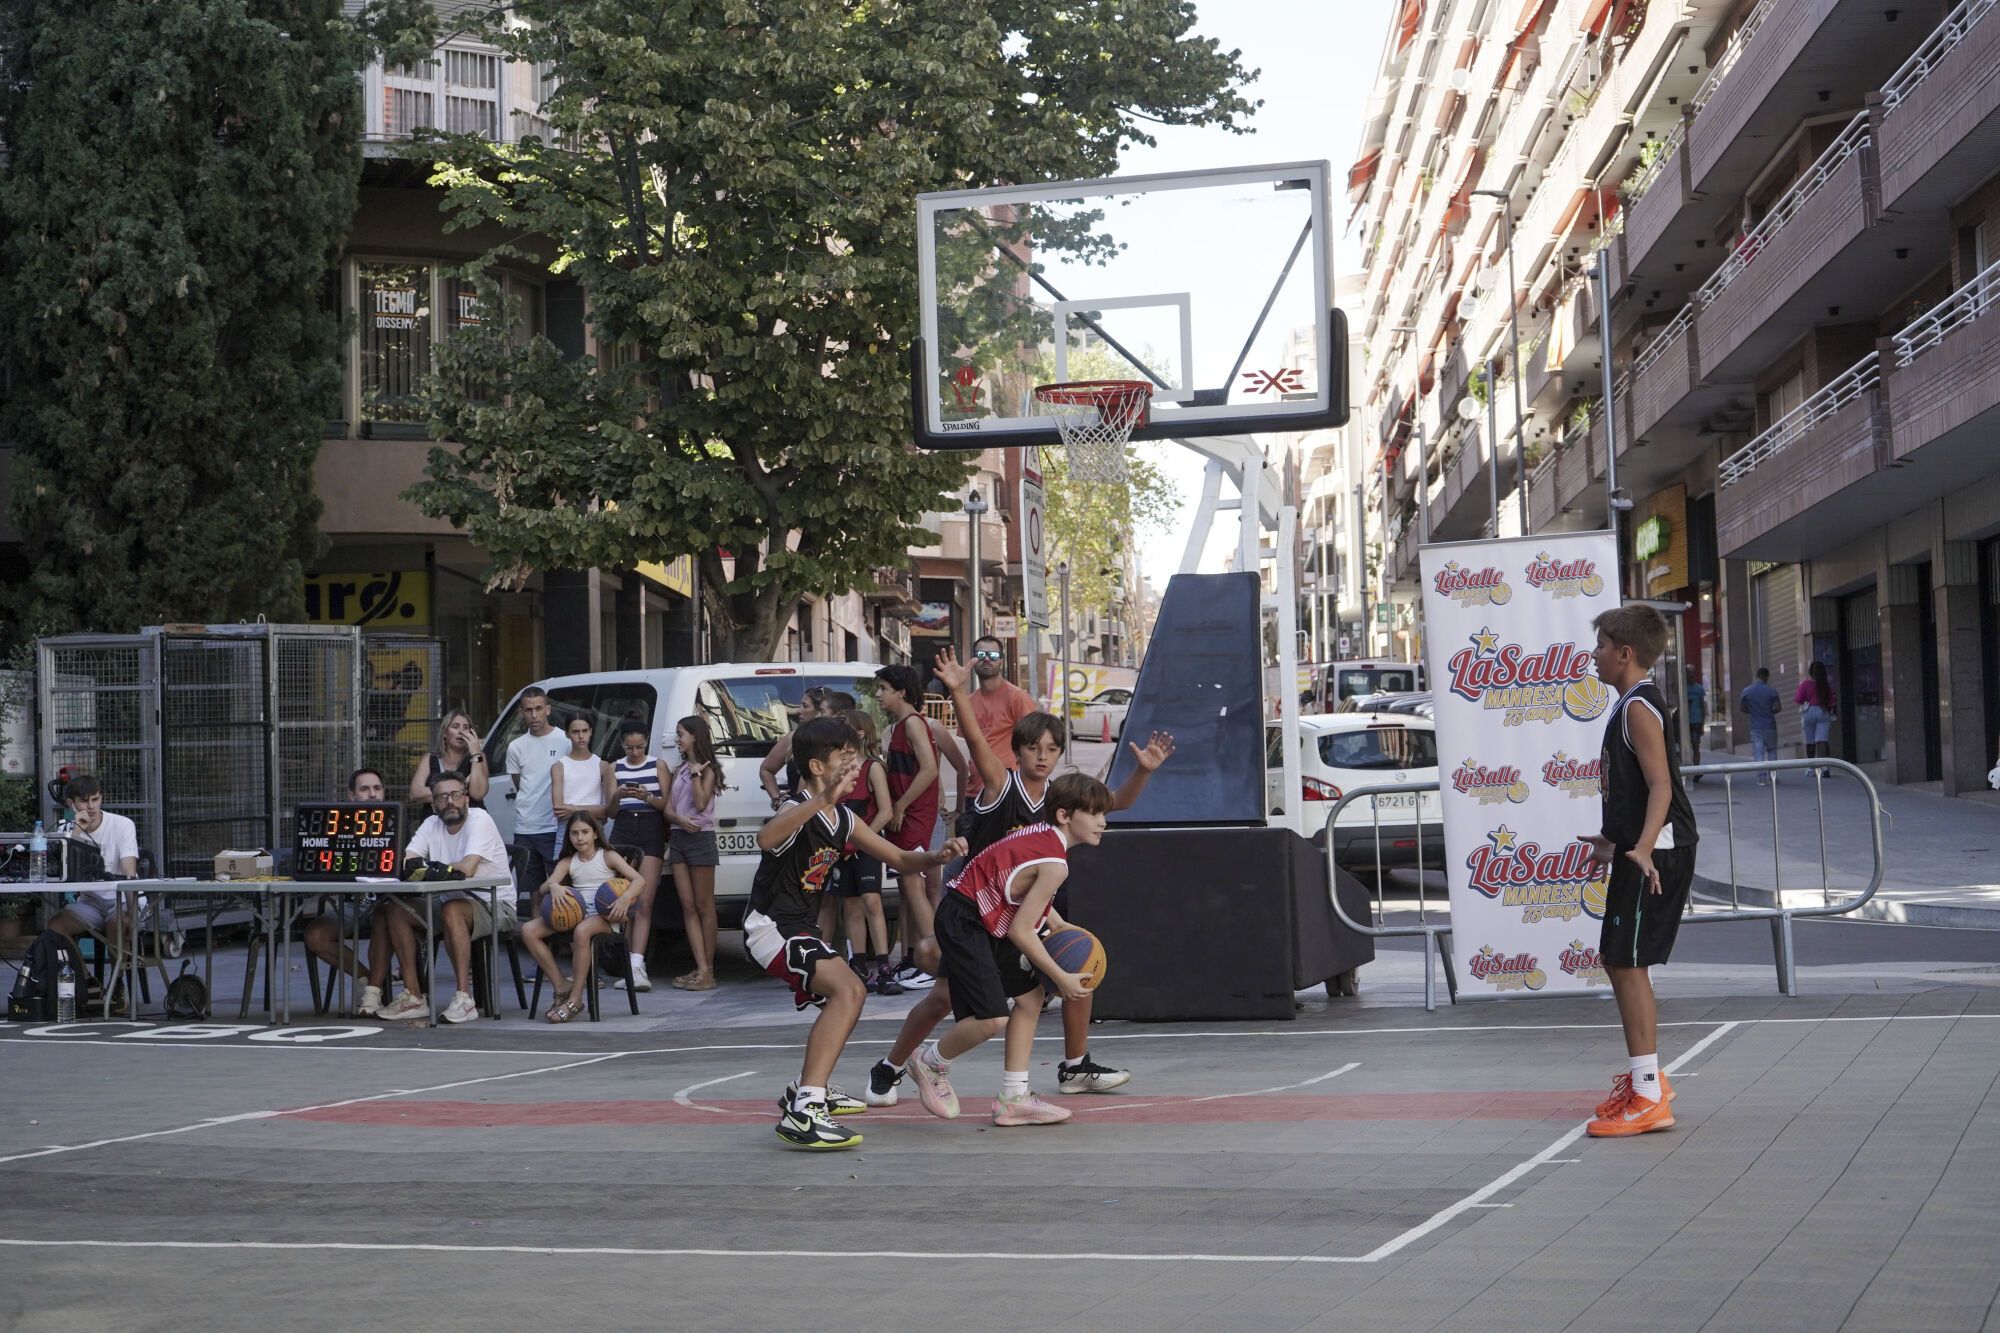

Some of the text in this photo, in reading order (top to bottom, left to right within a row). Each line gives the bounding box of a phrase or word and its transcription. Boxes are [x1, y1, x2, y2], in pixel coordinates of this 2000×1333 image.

[376, 317, 414, 330] DISSENY
[942, 421, 980, 432] SPALDING
[1434, 567, 1504, 596] LaSalle
[1525, 558, 1595, 588] LaSalle
[1448, 642, 1593, 702] LaSalle
[1484, 685, 1563, 709] MANRESA
[1503, 708, 1525, 727] 75
[1452, 765, 1522, 793] LaSalle
[1542, 758, 1601, 787] LaSall
[1379, 795, 1428, 807] 6721 GT
[327, 810, 384, 835] 3:59
[302, 837, 329, 848] HOME
[360, 837, 391, 848] GUEST
[718, 835, 755, 850] 3303
[320, 850, 332, 871] 4
[380, 850, 394, 872] 8
[1502, 884, 1581, 906] MANRESA
[1522, 906, 1544, 923] 75
[1470, 953, 1538, 980] LaSalle
